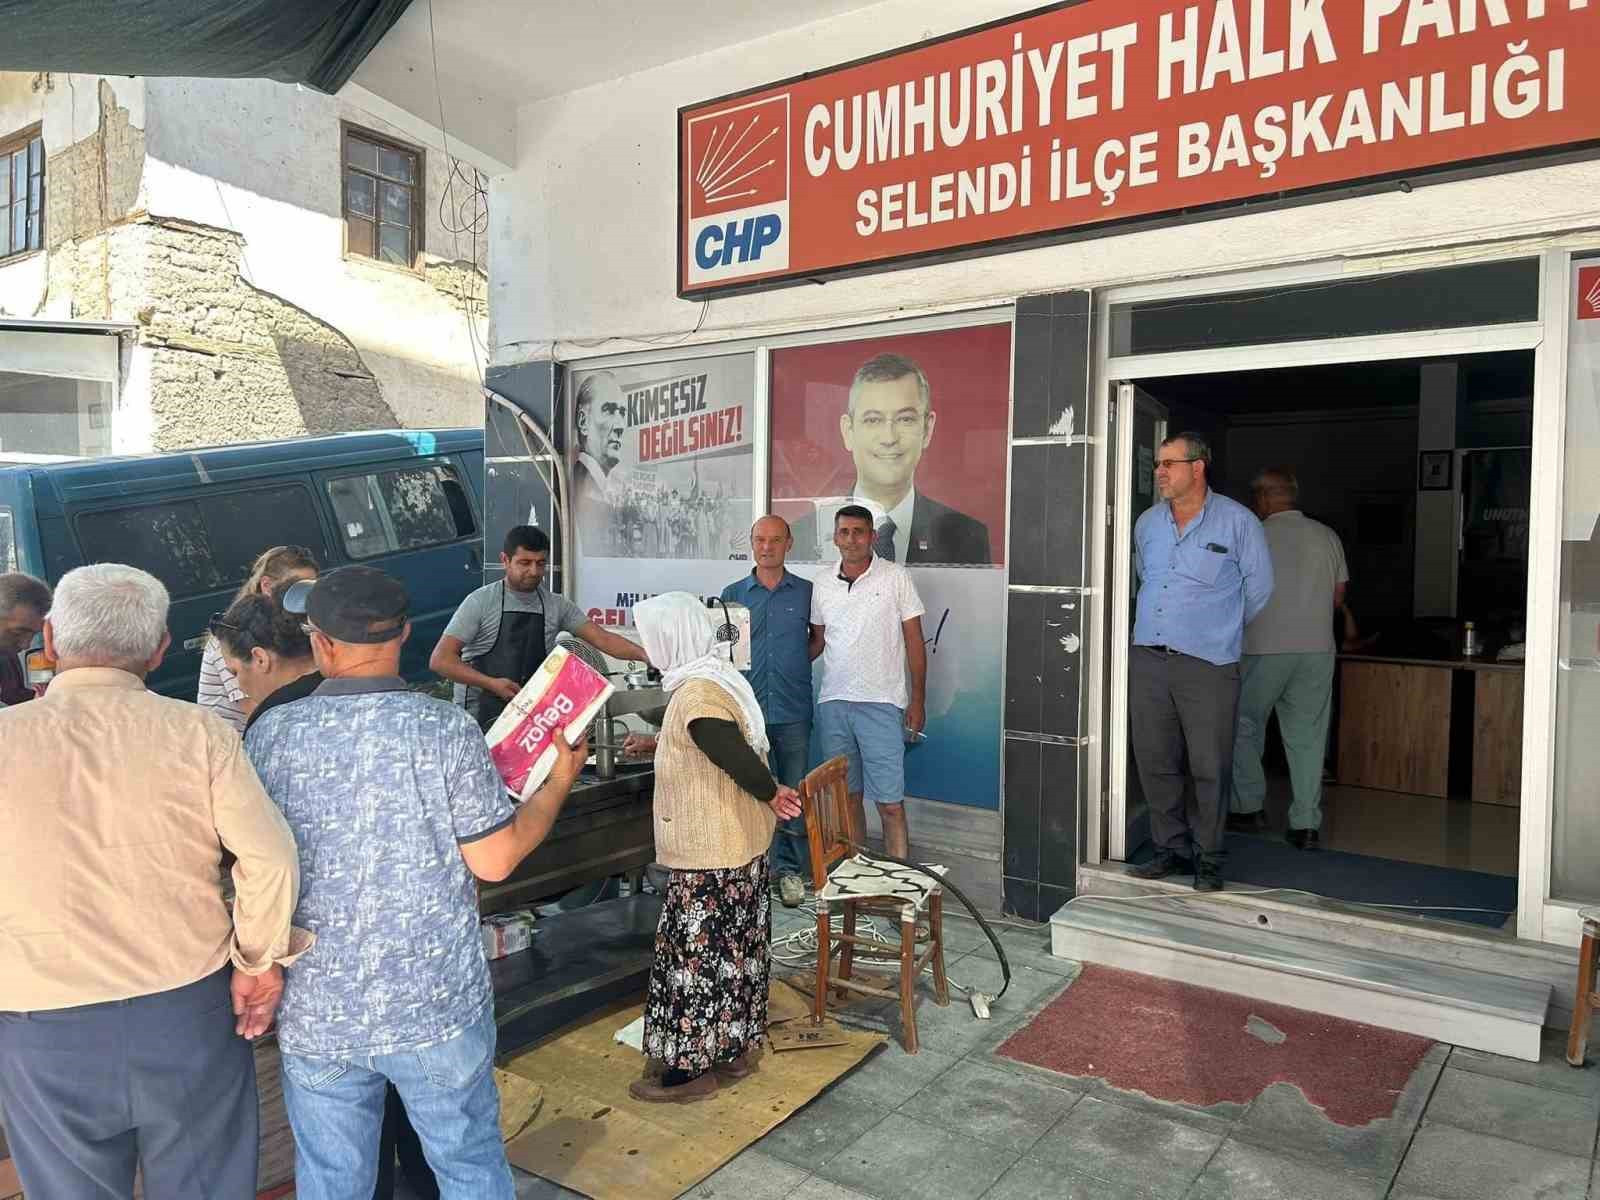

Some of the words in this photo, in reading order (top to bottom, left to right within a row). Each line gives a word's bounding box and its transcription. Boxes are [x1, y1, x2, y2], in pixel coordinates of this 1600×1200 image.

[804, 23, 1138, 178] CUMHURİYET
[1157, 0, 1338, 100] HALK
[855, 145, 1031, 237] SELENDİ
[1050, 131, 1159, 206] İLÇE
[1177, 39, 1565, 178] BAŞKANLIĞI
[695, 214, 782, 271] CHP
[519, 692, 574, 753] Beyaz
